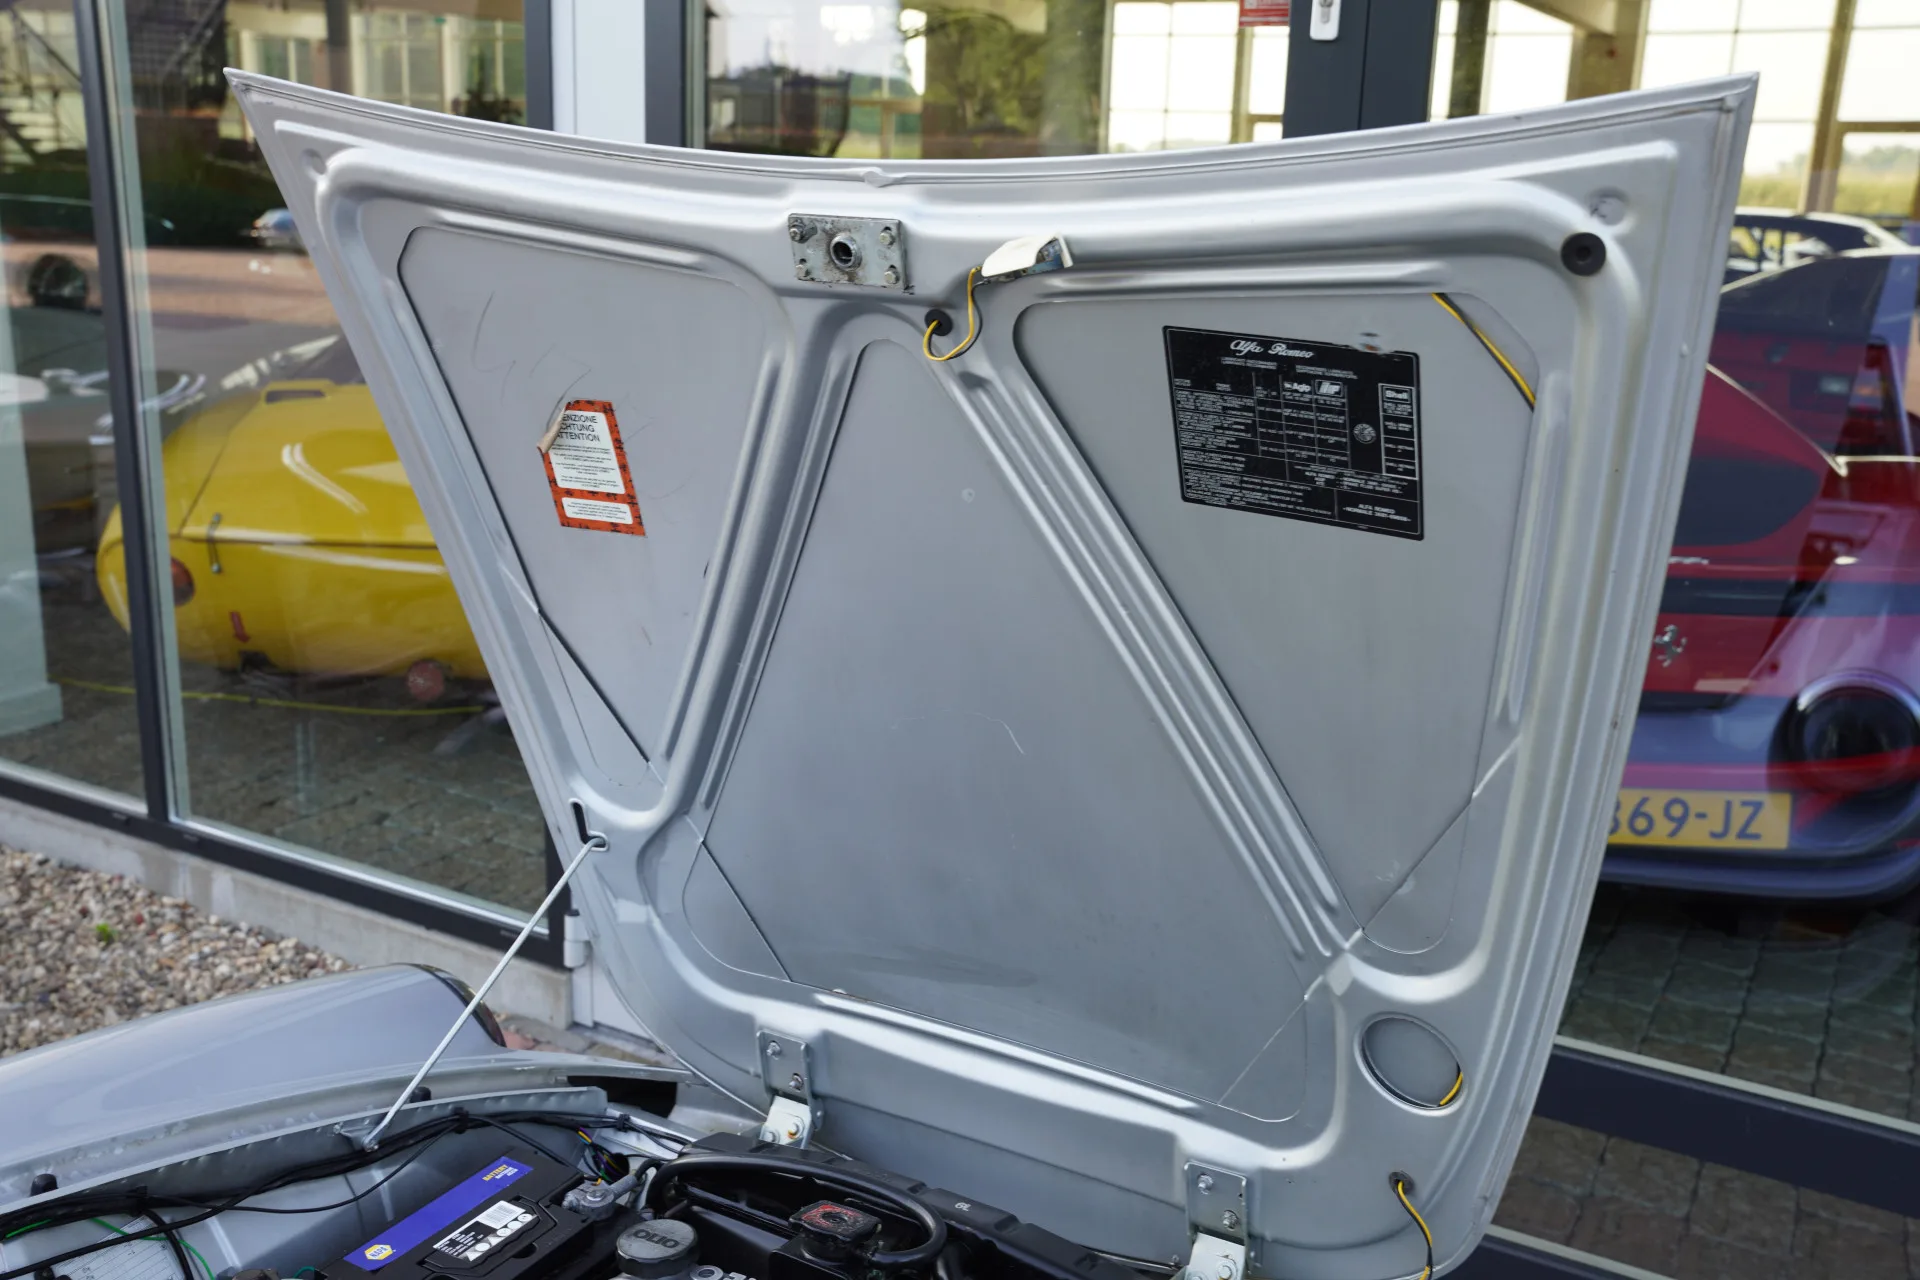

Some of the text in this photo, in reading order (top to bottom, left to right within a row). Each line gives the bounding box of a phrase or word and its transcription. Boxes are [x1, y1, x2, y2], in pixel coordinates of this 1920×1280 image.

[1230, 340, 1314, 358] Alfa Romeo
[1385, 390, 1408, 399] Shell
[633, 1229, 679, 1248] OLIO
